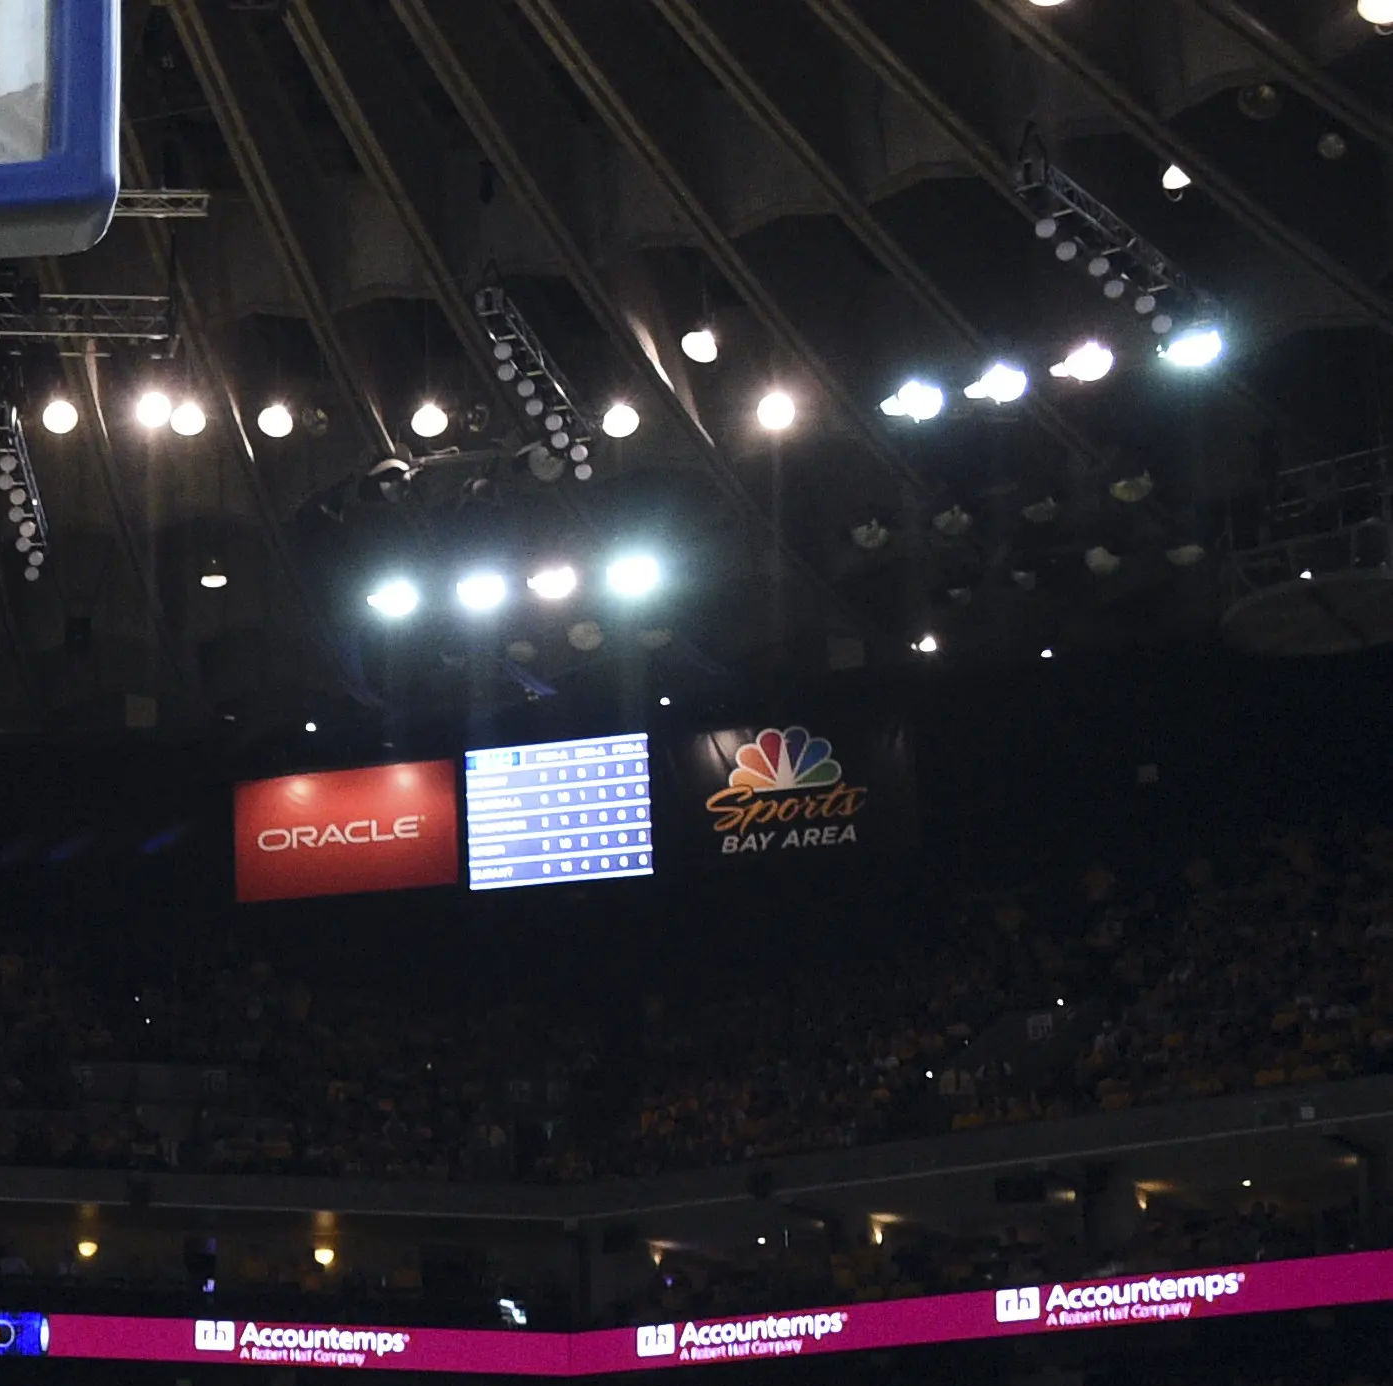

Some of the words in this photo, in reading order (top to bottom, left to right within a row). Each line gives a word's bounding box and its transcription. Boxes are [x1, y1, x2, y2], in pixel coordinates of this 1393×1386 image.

[706, 782, 868, 836] Sports
[258, 815, 420, 851] ORACLE
[722, 831, 775, 853] BAY
[782, 824, 857, 848] AREA
[1045, 1272, 1239, 1312] Accountemps
[679, 1312, 843, 1348] Accountemps
[1046, 1312, 1058, 1326] A
[239, 1322, 405, 1357] Accountemps
[239, 1347, 250, 1360] A
[679, 1348, 690, 1361] A
